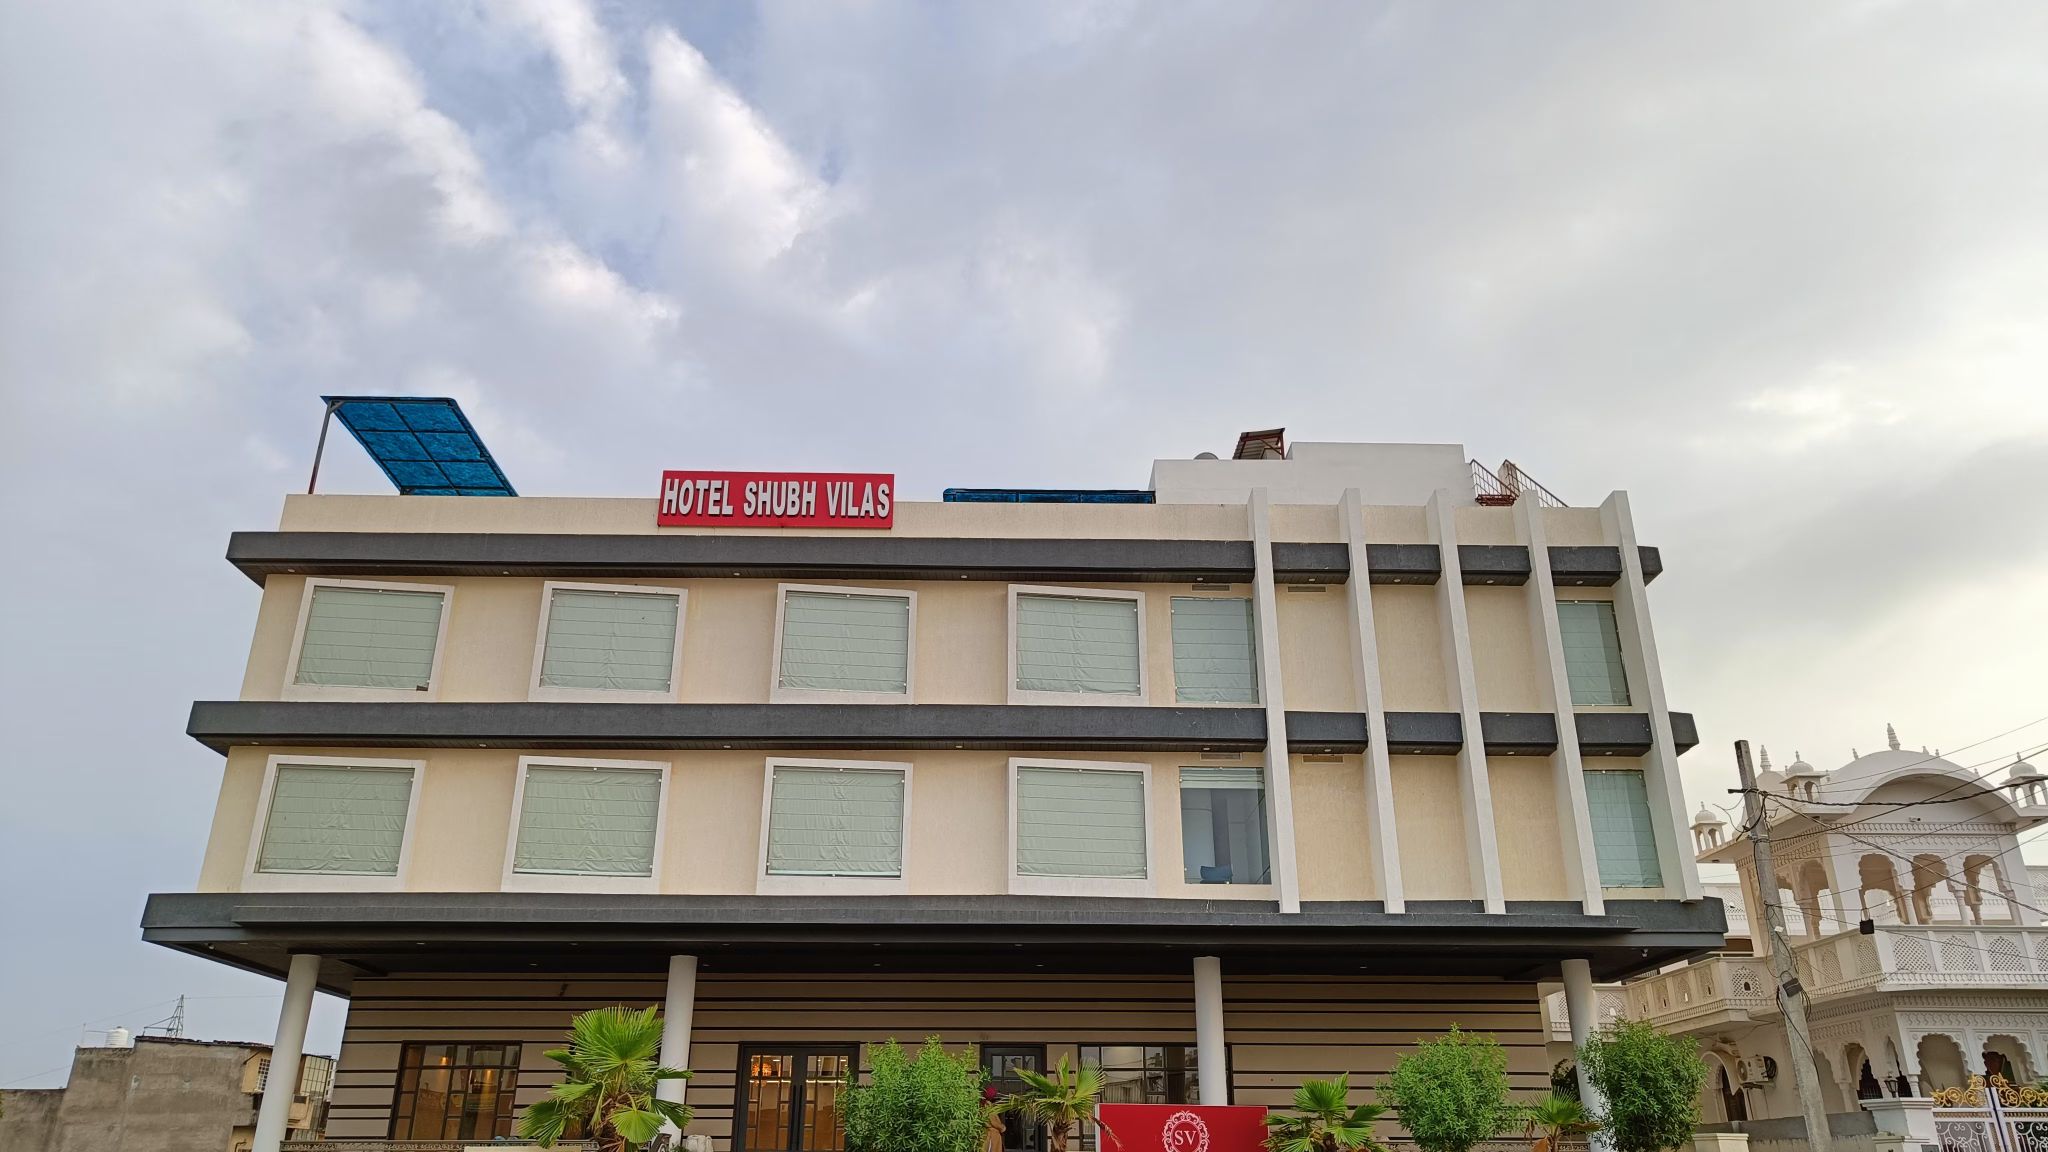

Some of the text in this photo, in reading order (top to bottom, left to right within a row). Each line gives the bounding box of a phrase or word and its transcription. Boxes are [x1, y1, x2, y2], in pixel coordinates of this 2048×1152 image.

[662, 478, 890, 518] HOTEL SHUBH VILAS
[1174, 1130, 1198, 1146] SV
